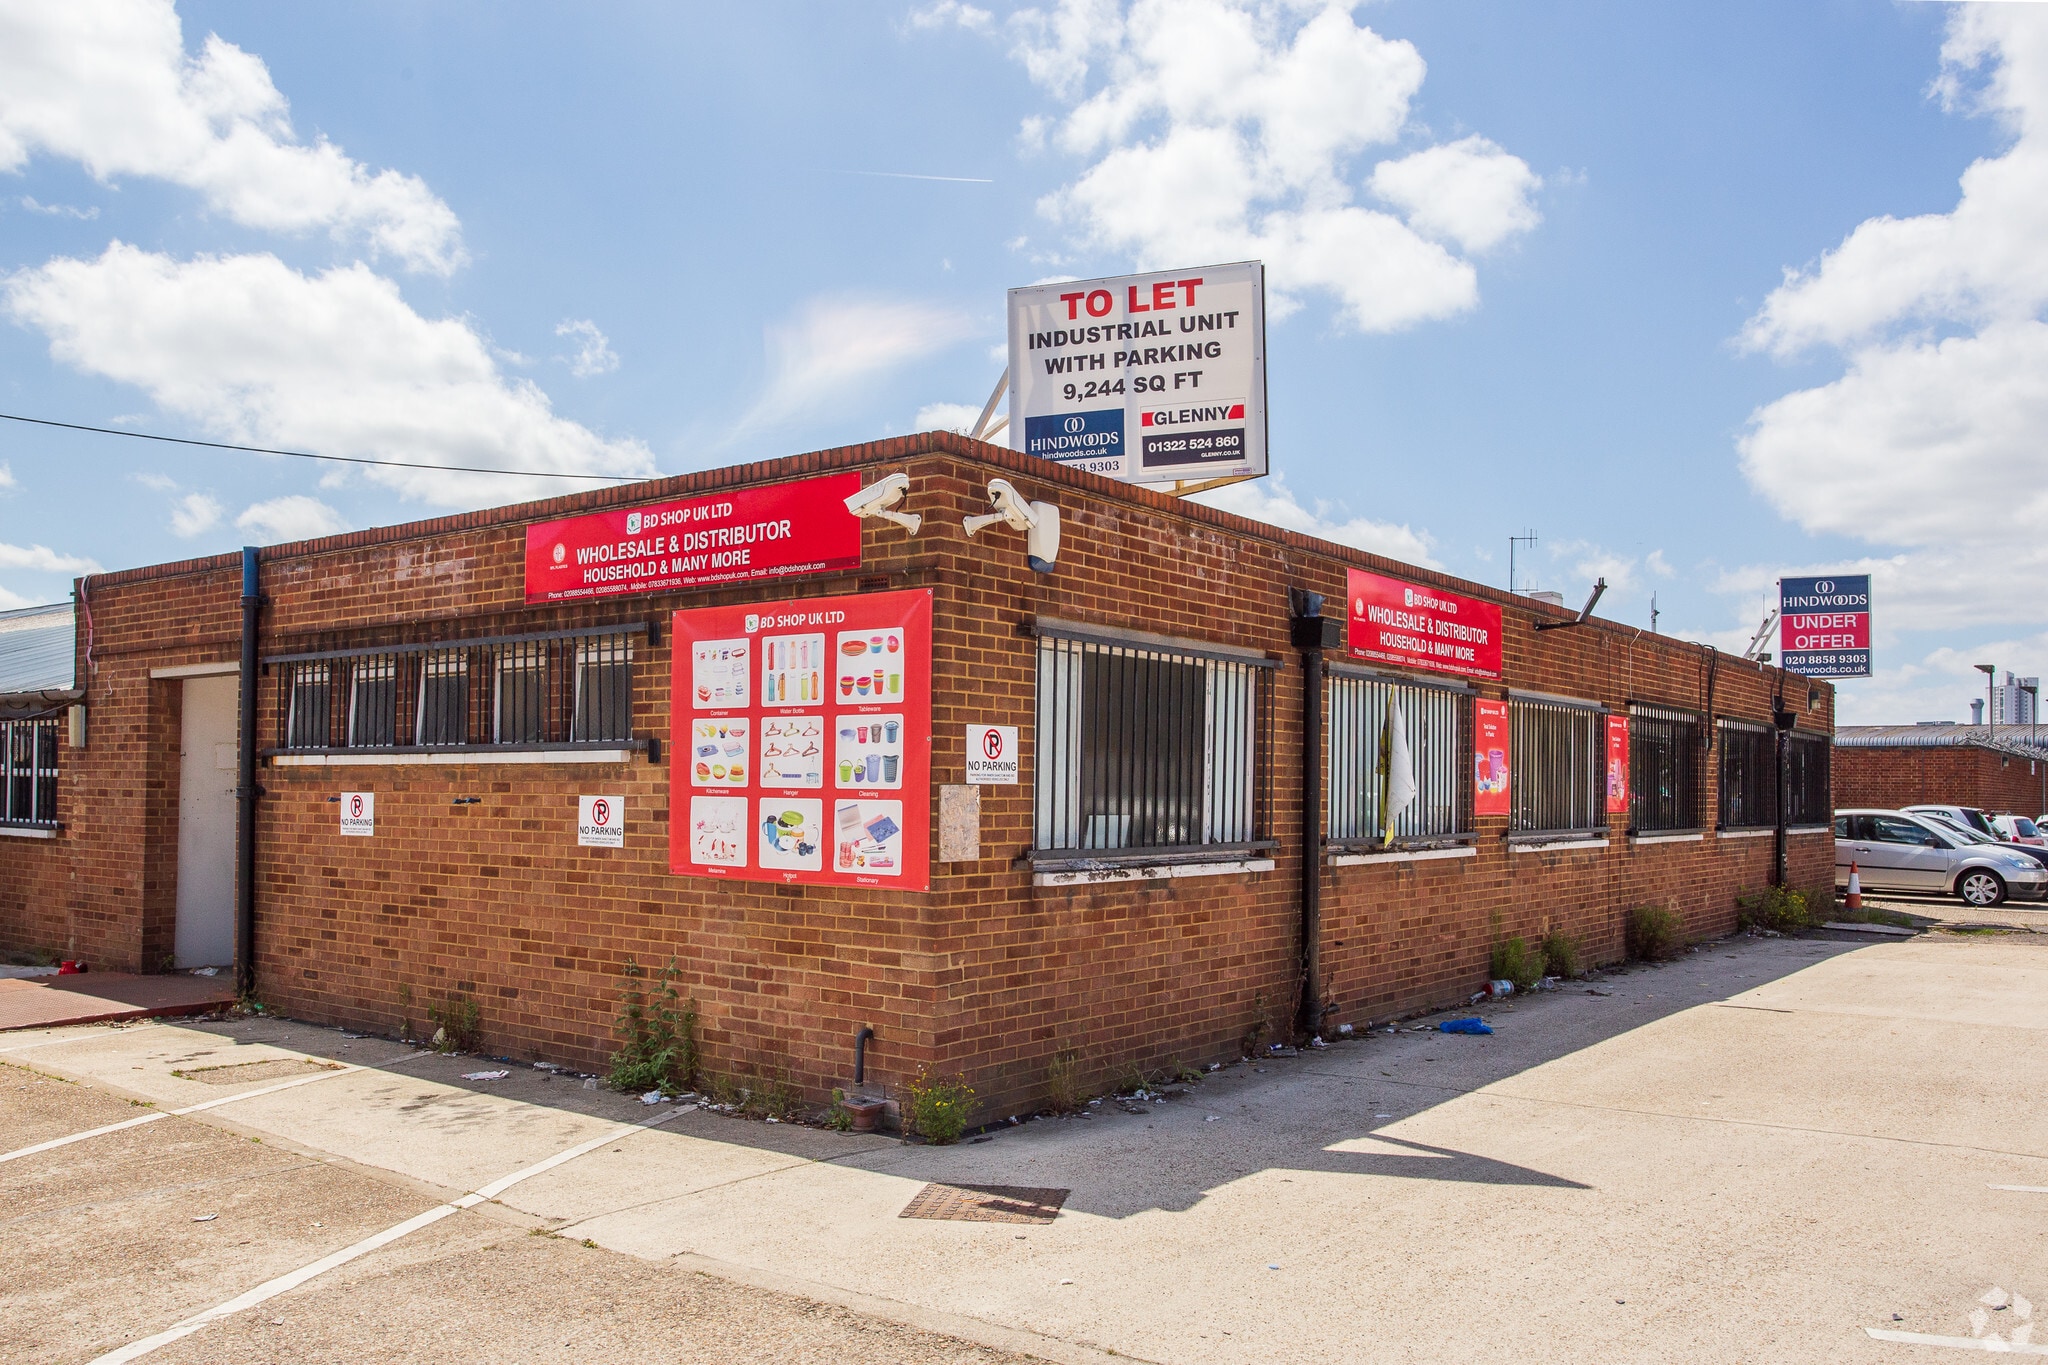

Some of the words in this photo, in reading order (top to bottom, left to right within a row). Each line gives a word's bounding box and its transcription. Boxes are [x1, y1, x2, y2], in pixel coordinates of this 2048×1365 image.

[1060, 289, 1113, 320] TO
[1128, 278, 1203, 313] LET
[1029, 319, 1172, 350] INDUSTRIAL
[1180, 311, 1239, 332] UNIT
[1045, 353, 1105, 375] WITH
[1114, 341, 1222, 368] PARKING
[1063, 378, 1126, 402] 9,244
[1133, 375, 1166, 393] SQ
[1174, 371, 1203, 389] FT
[1154, 406, 1230, 425] GLENNY
[1031, 431, 1119, 451] HINDWOODS
[1148, 440, 1187, 453] 01322
[1189, 437, 1213, 450] 524
[1215, 435, 1239, 447] 860
[1042, 447, 1108, 460] hindwoods.co.uk
[1201, 450, 1240, 458] GLENNY.CO.UK
[1089, 460, 1120, 473] 9303
[643, 513, 659, 529] BD
[660, 508, 691, 526] SHOP
[692, 505, 709, 521] UK
[711, 502, 733, 519] LTD
[576, 536, 665, 565] WHOLESALE
[668, 535, 680, 553] &
[683, 519, 792, 552] DISTRIBUTOR
[583, 561, 657, 584] HOUSEHOLD
[659, 559, 669, 575] &
[671, 555, 709, 572] MANY
[711, 549, 750, 568] MORE
[697, 571, 750, 582] www.bdshopuk.com,
[751, 568, 768, 577] Email:
[768, 562, 825, 576] info@bdshopuk.com
[1414, 594, 1422, 606] BD
[1423, 596, 1438, 610] SHOP
[1439, 600, 1448, 612] UK
[1448, 602, 1458, 614] LTD
[1783, 594, 1867, 608] HINDWOODS
[760, 616, 775, 629] BD
[777, 614, 806, 627] SHOP
[808, 612, 823, 625] UK
[825, 610, 845, 624] LTD
[1368, 604, 1426, 632] WHOLESALE
[1428, 618, 1434, 634] &
[1436, 619, 1488, 646] DISTRIBUTOR
[1793, 614, 1857, 629] UNDER
[1380, 631, 1426, 653] HOUSEHOLD
[1428, 640, 1434, 654] &
[1434, 642, 1454, 658] MANY
[1456, 646, 1475, 662] MORE
[1795, 634, 1855, 648] OFFER
[1786, 656, 1806, 665] 020
[1808, 655, 1836, 664] 8858
[1839, 654, 1867, 663] 9303
[968, 760, 980, 770] NO
[982, 761, 1016, 771] PARKING
[580, 826, 589, 834] NO
[591, 826, 622, 836] PARKING
[856, 876, 878, 885] Stationary
